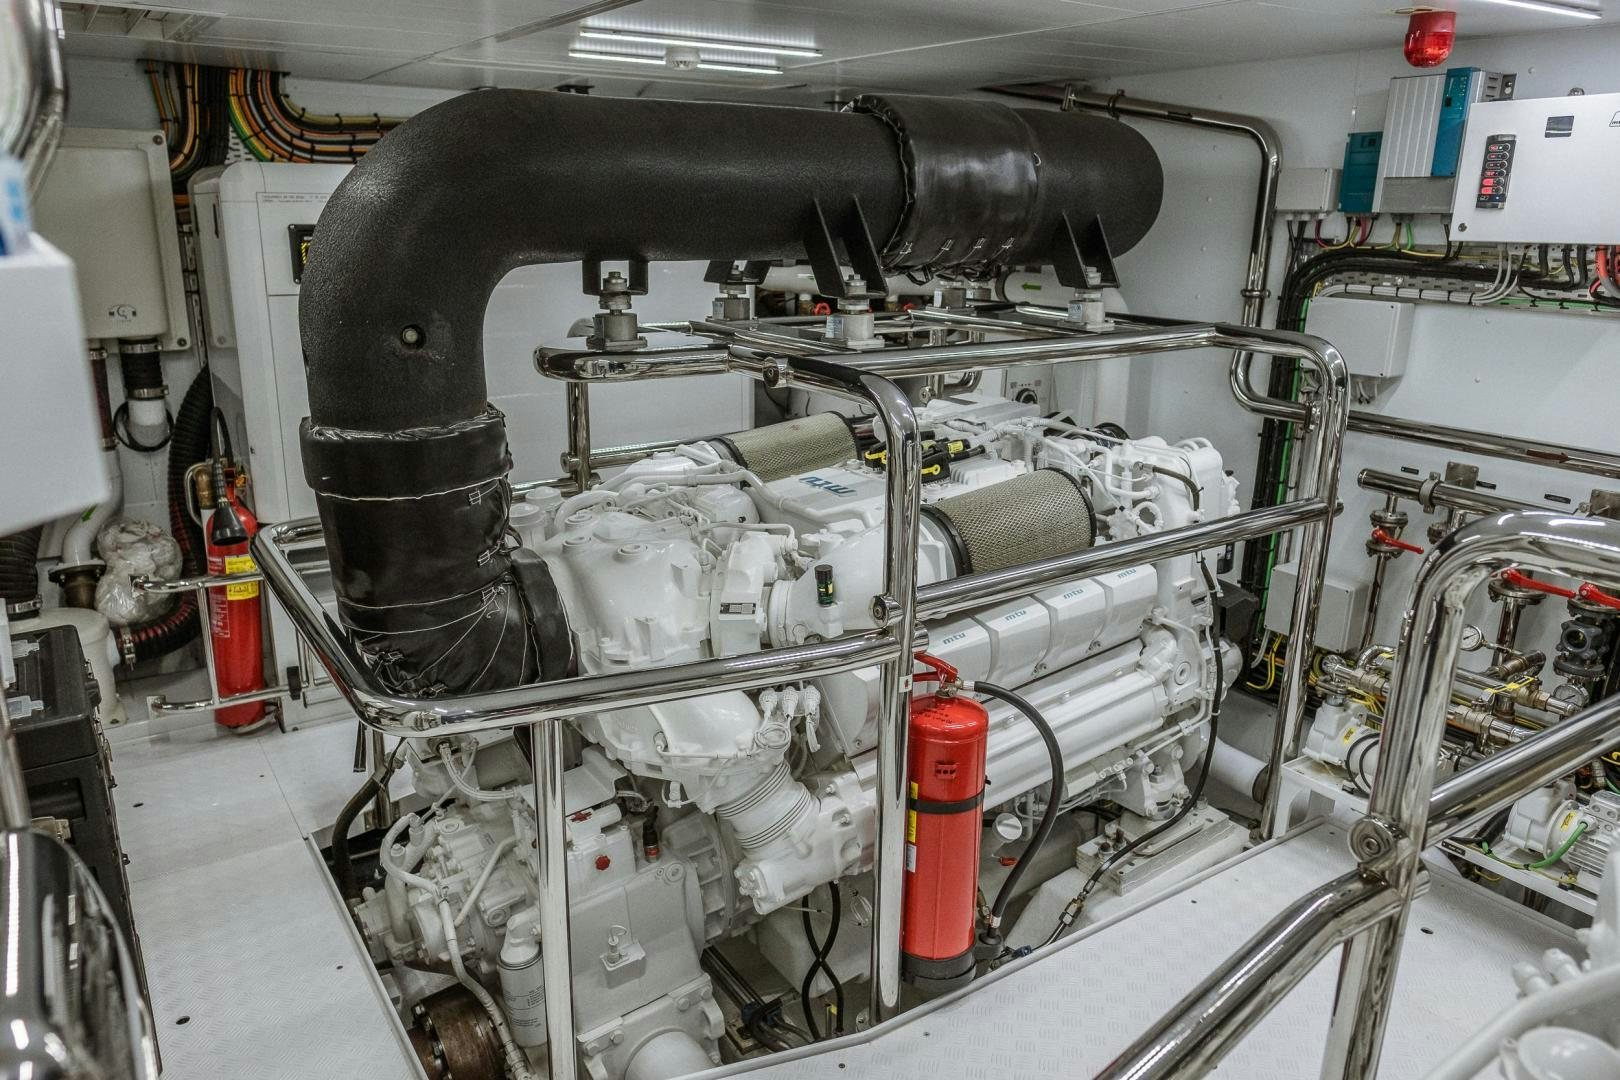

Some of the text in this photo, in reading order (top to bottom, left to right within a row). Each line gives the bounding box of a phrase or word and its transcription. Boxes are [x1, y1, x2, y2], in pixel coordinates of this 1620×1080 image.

[1063, 589, 1084, 599] mtu
[1005, 610, 1026, 621] mtu
[943, 633, 966, 645] mtu
